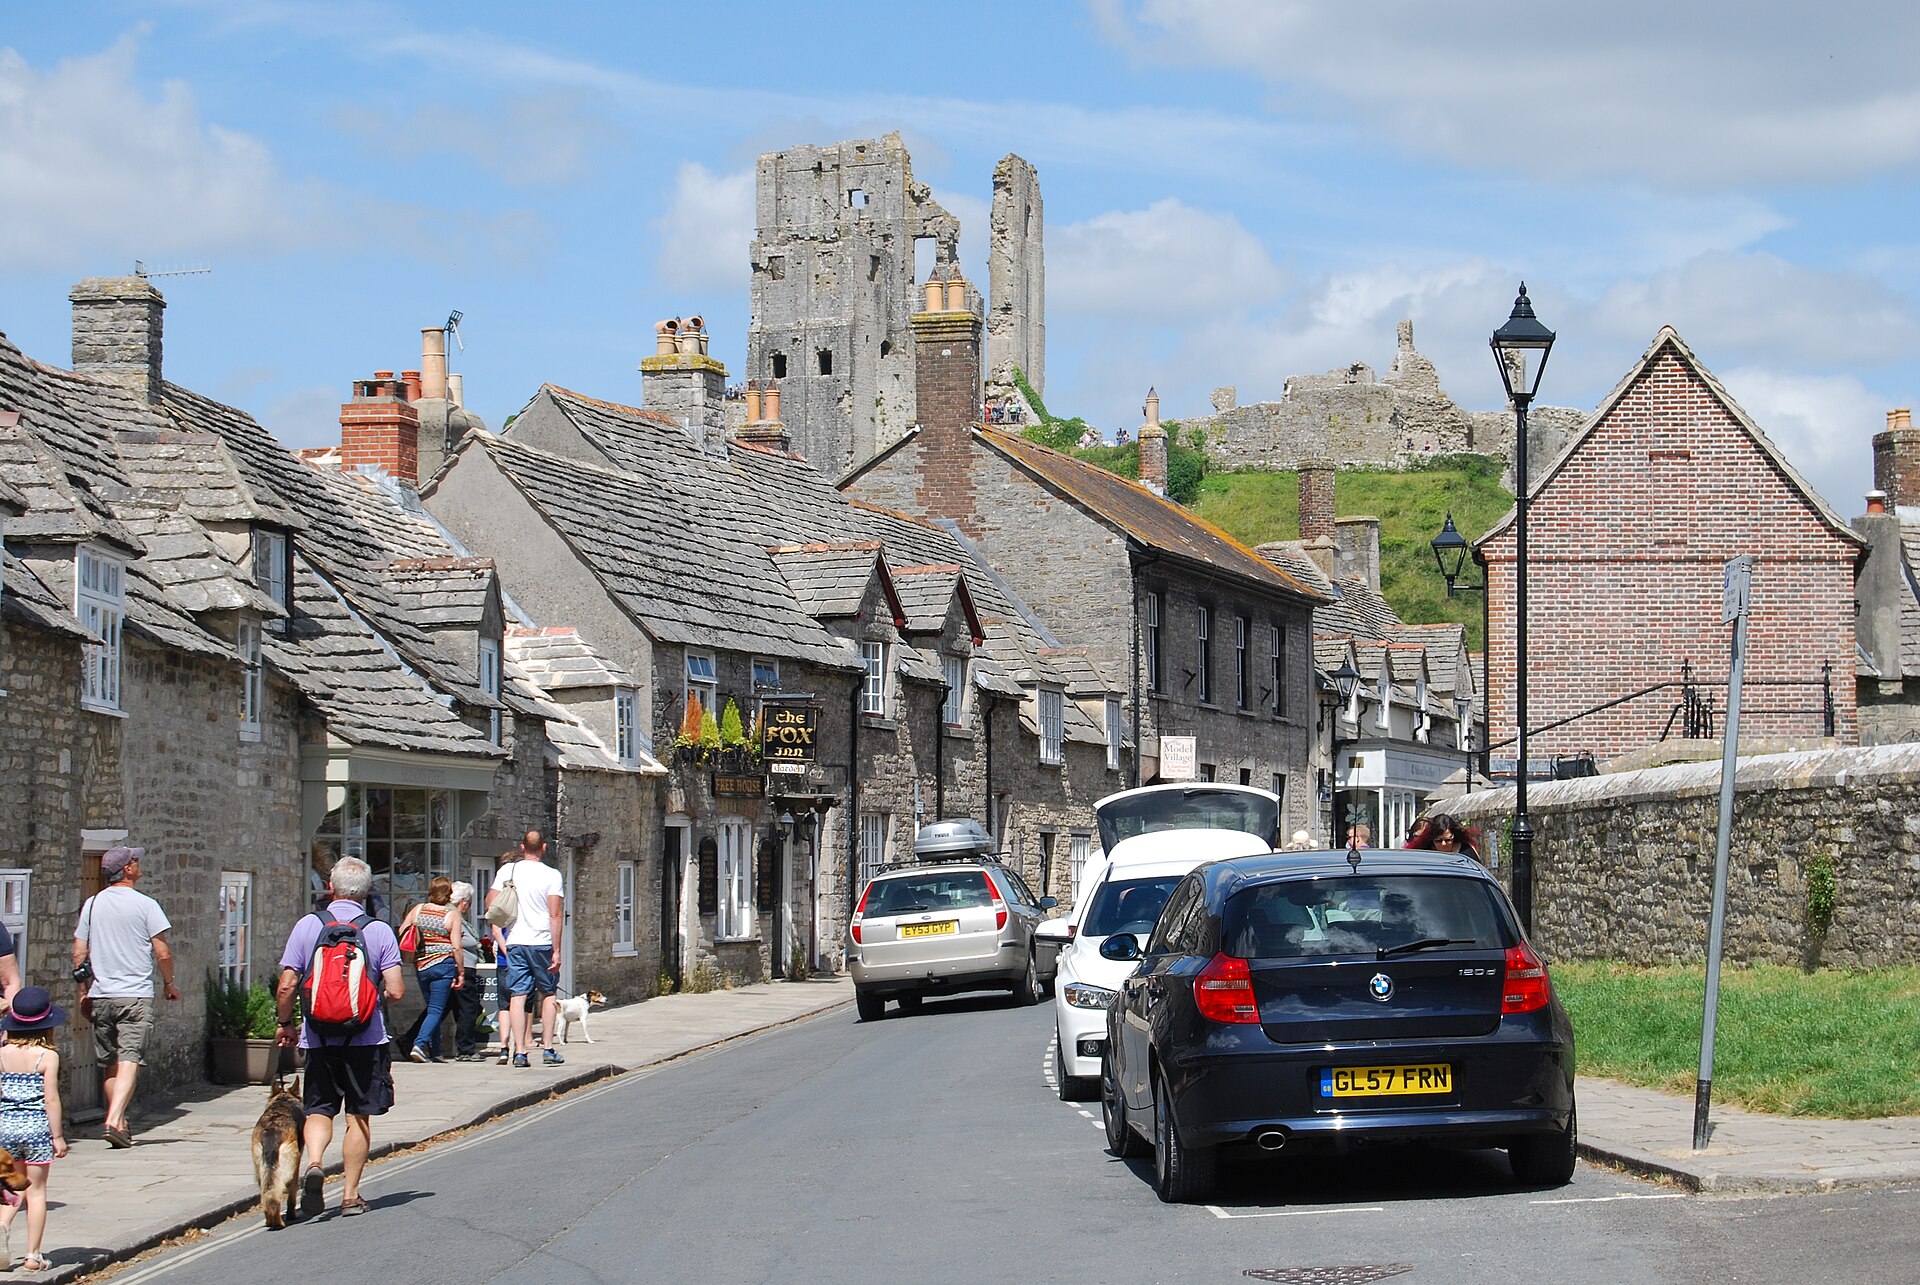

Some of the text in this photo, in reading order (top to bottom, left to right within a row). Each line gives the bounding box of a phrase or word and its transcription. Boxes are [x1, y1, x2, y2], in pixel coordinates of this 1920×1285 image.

[766, 726, 813, 744] FOX
[1164, 742, 1193, 753] Model
[1164, 753, 1193, 764] Village
[715, 778, 761, 793] FREE HOUSE
[905, 922, 951, 936] EY53 GYP
[1335, 1067, 1447, 1091] GL57 FRN
